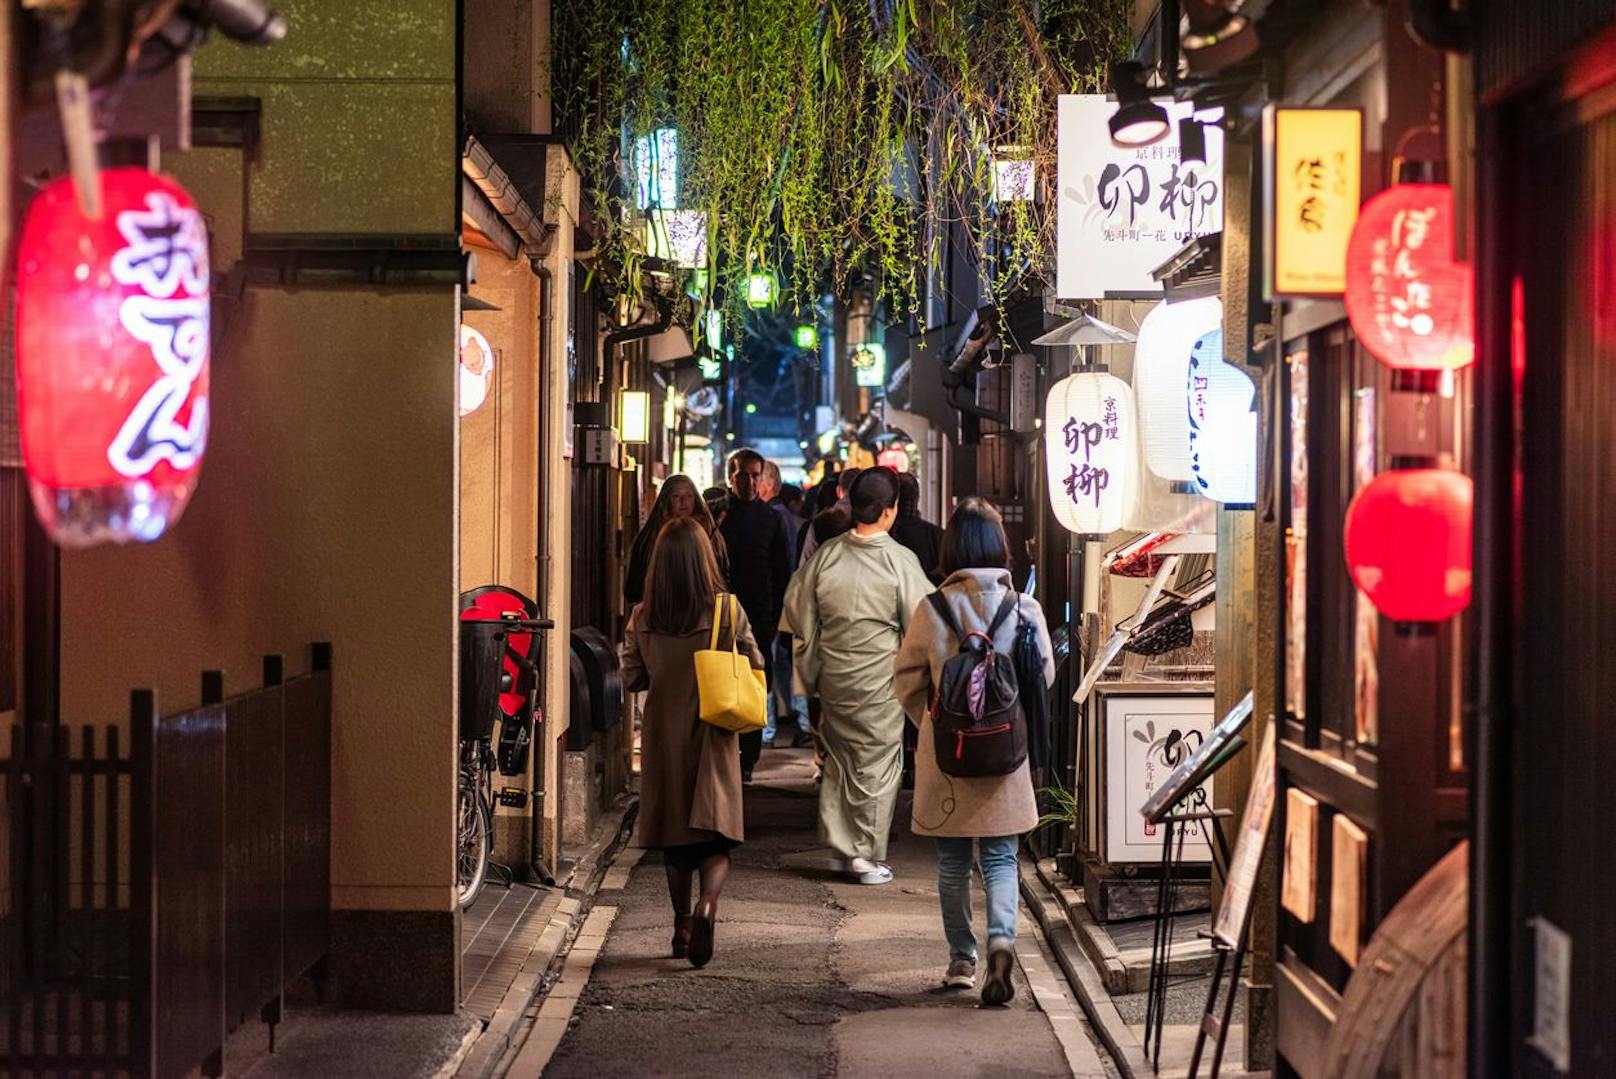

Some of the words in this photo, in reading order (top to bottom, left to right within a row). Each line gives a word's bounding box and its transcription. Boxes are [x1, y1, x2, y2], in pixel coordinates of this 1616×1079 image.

[1097, 163, 1218, 231] 卯柳
[1103, 396, 1119, 440] 京料理
[1062, 416, 1110, 509] 卯柳
